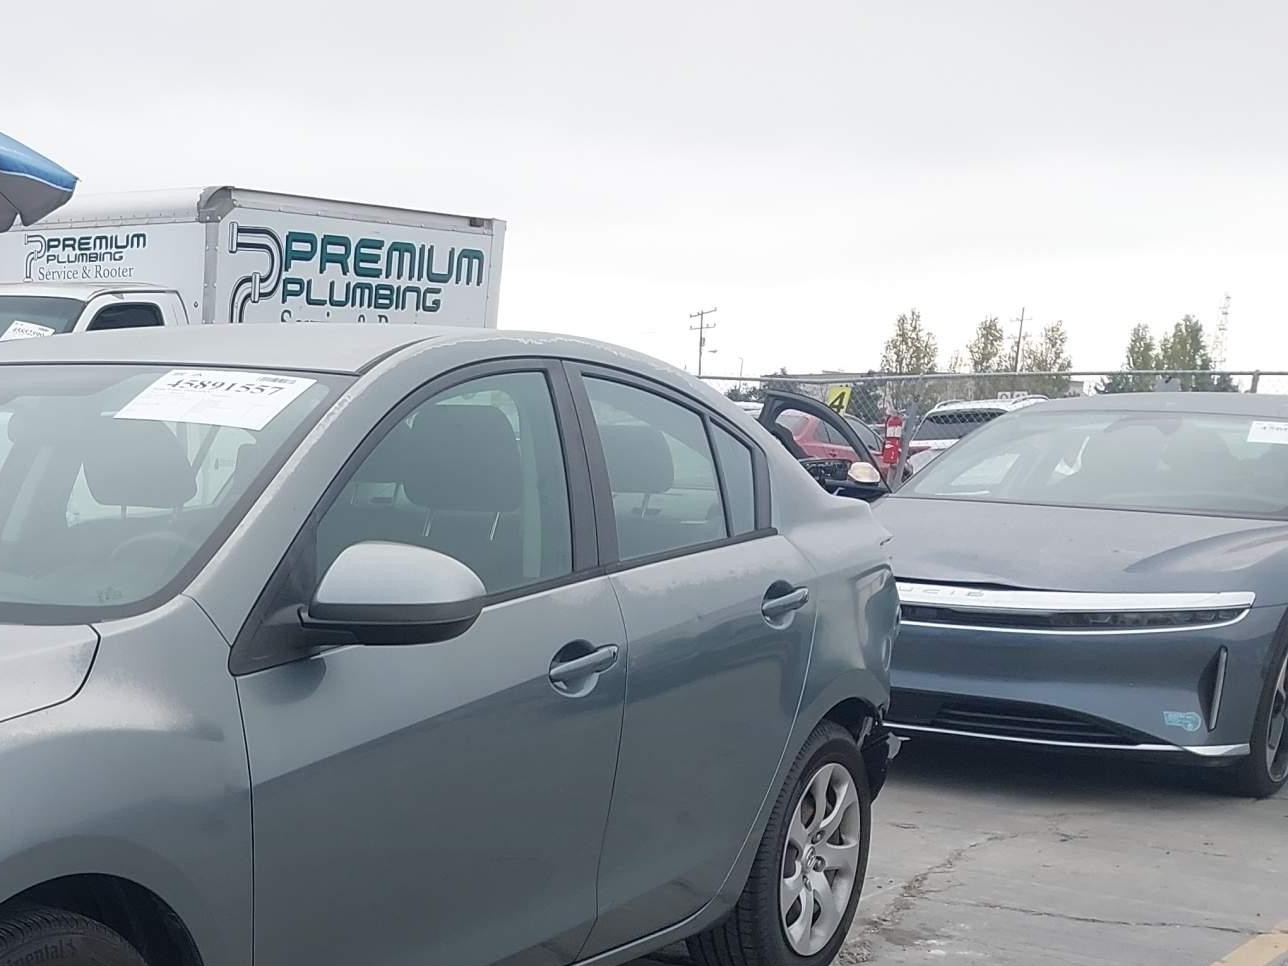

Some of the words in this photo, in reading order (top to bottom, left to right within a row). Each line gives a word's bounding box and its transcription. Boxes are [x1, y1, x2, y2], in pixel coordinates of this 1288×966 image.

[46, 232, 147, 252] PREMIUM
[46, 250, 124, 265] PLUMBING
[284, 231, 485, 287] PREMIUM
[38, 266, 79, 281] Service
[81, 265, 92, 279] &
[95, 264, 134, 279] Rooter
[281, 277, 442, 313] PLUMBING
[167, 379, 285, 396] 45891557
[828, 391, 847, 413] 4
